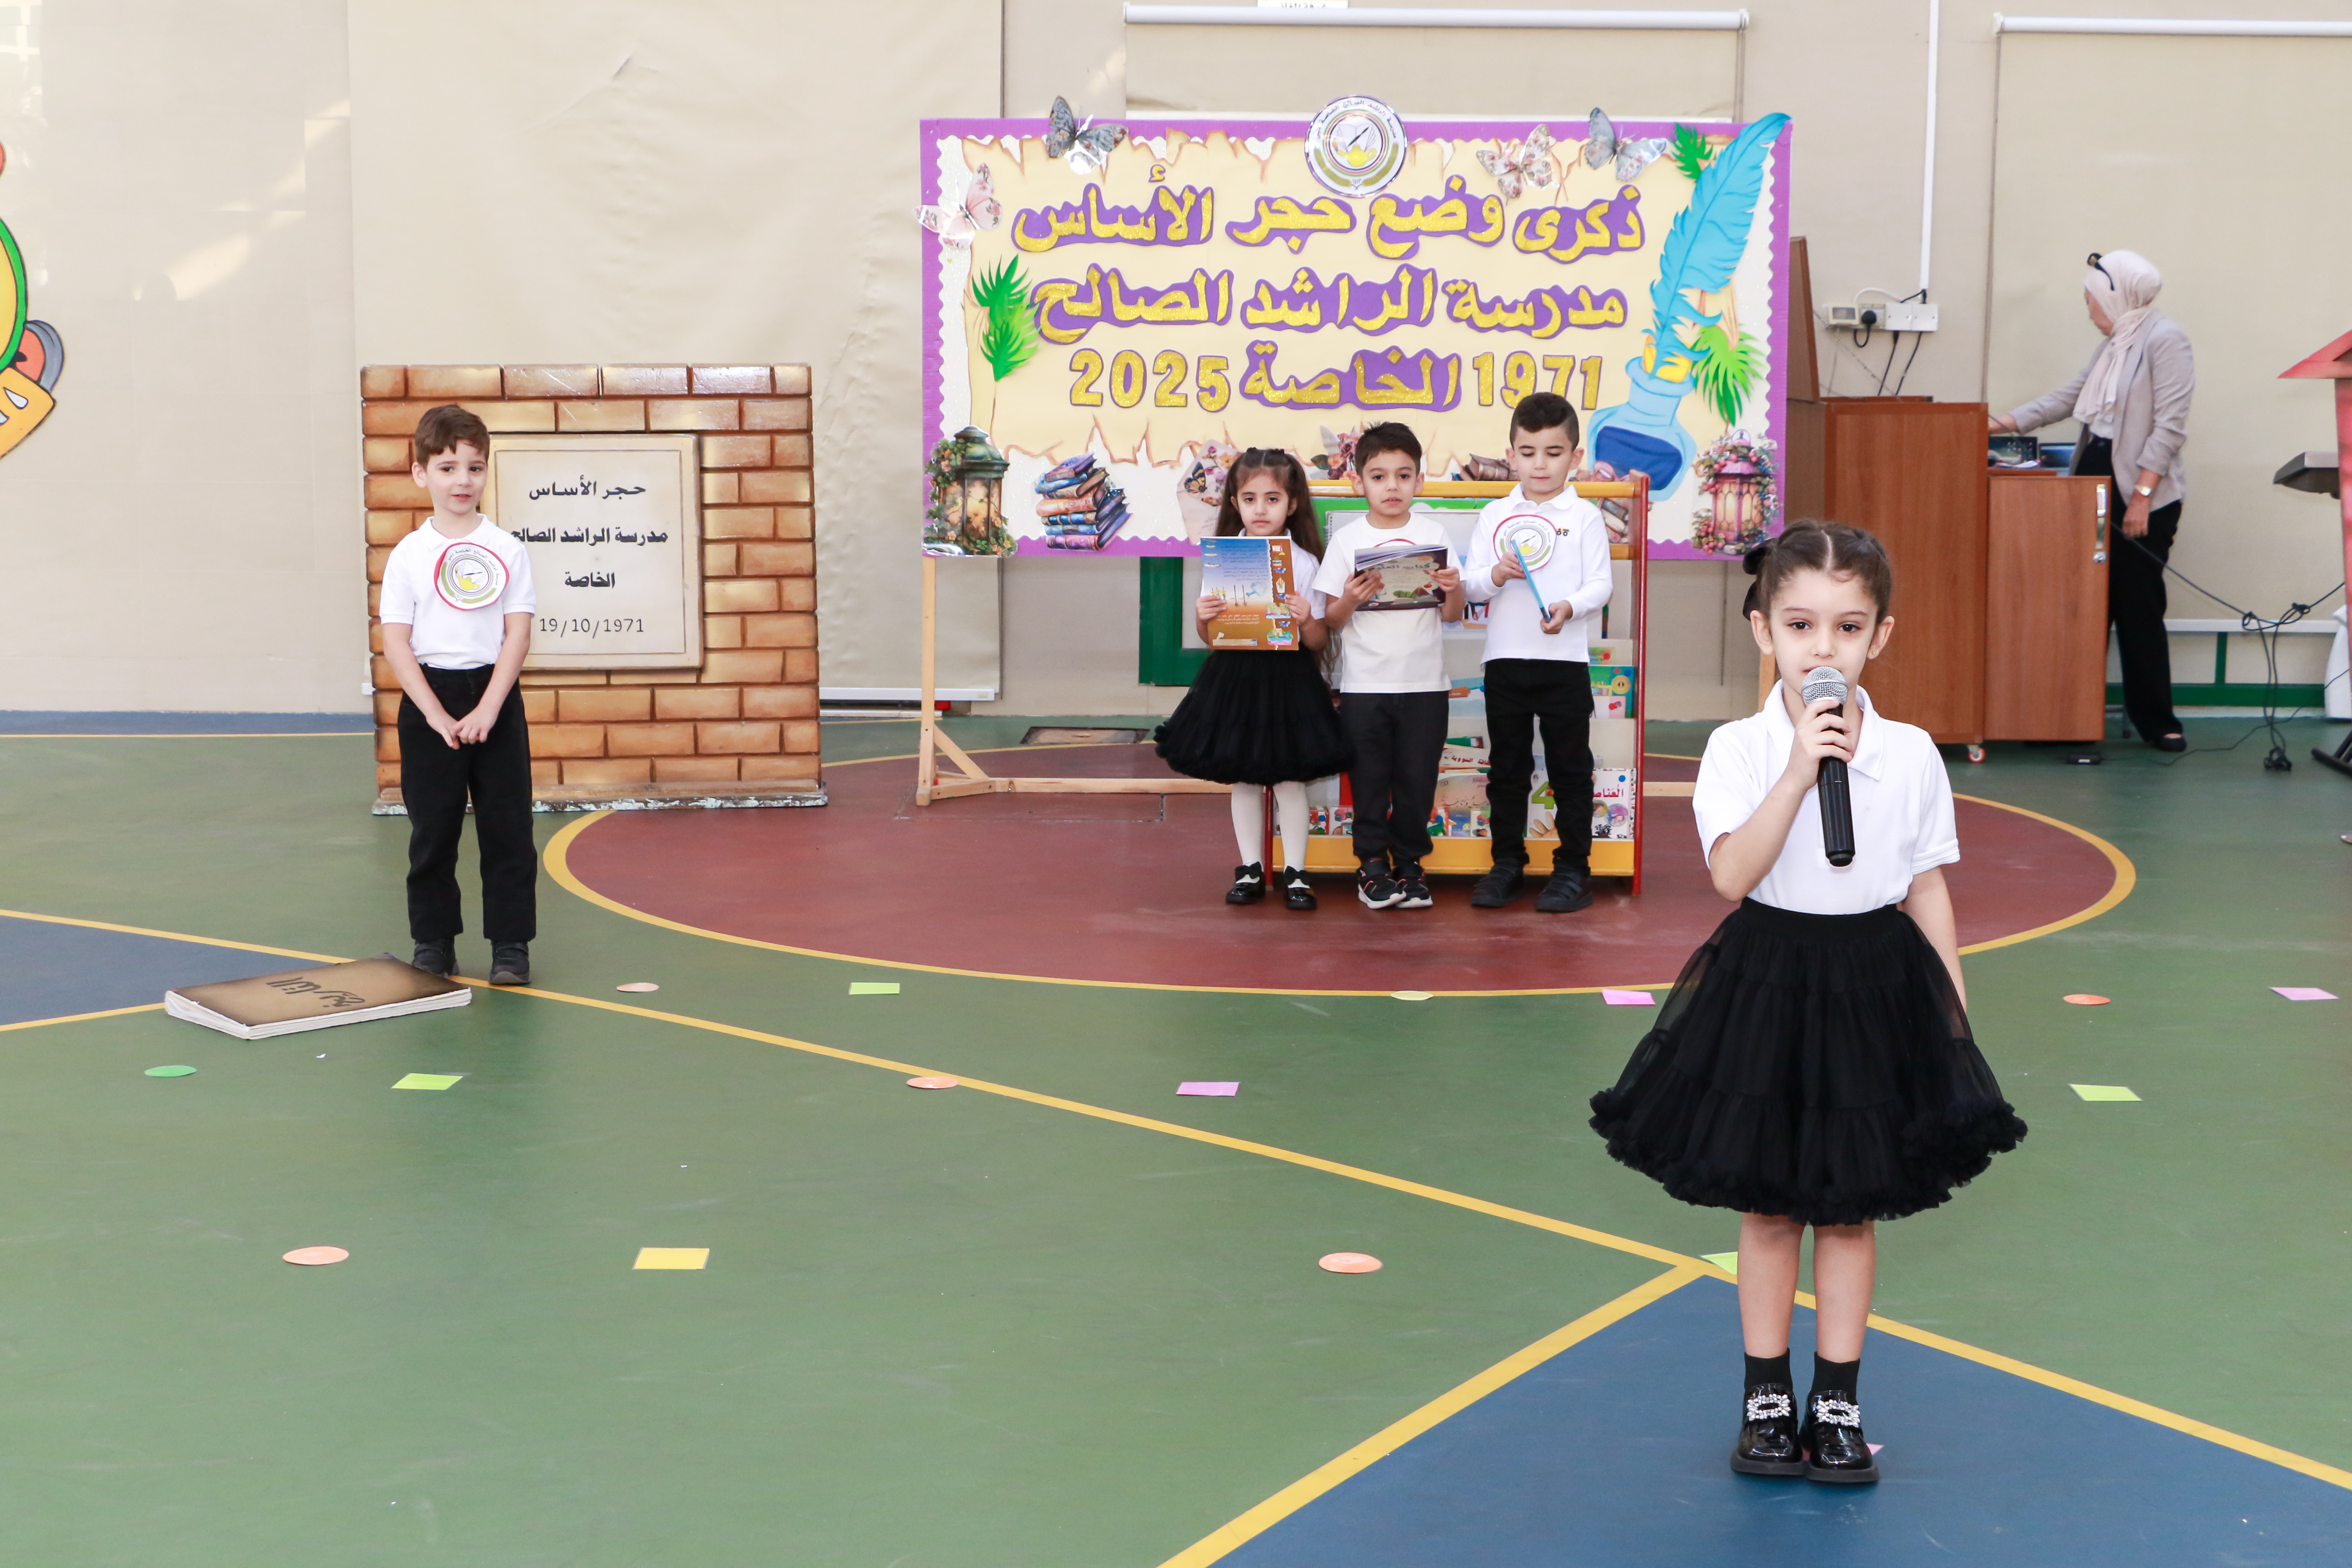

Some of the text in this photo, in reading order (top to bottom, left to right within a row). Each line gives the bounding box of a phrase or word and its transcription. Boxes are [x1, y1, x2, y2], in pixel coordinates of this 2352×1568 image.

[1014, 165, 1641, 262] ذكرى وضع حجر الأساس
[1033, 266, 1624, 343] مدرسة الراشد الصالح
[1070, 342, 1602, 413] 1971 الخاصة 2025
[529, 475, 646, 500] حجر الأساس
[560, 527, 610, 546] الراشد
[614, 527, 668, 546] مدرسة
[564, 571, 616, 588] الخاصة
[539, 618, 644, 639] 19/10/1971
